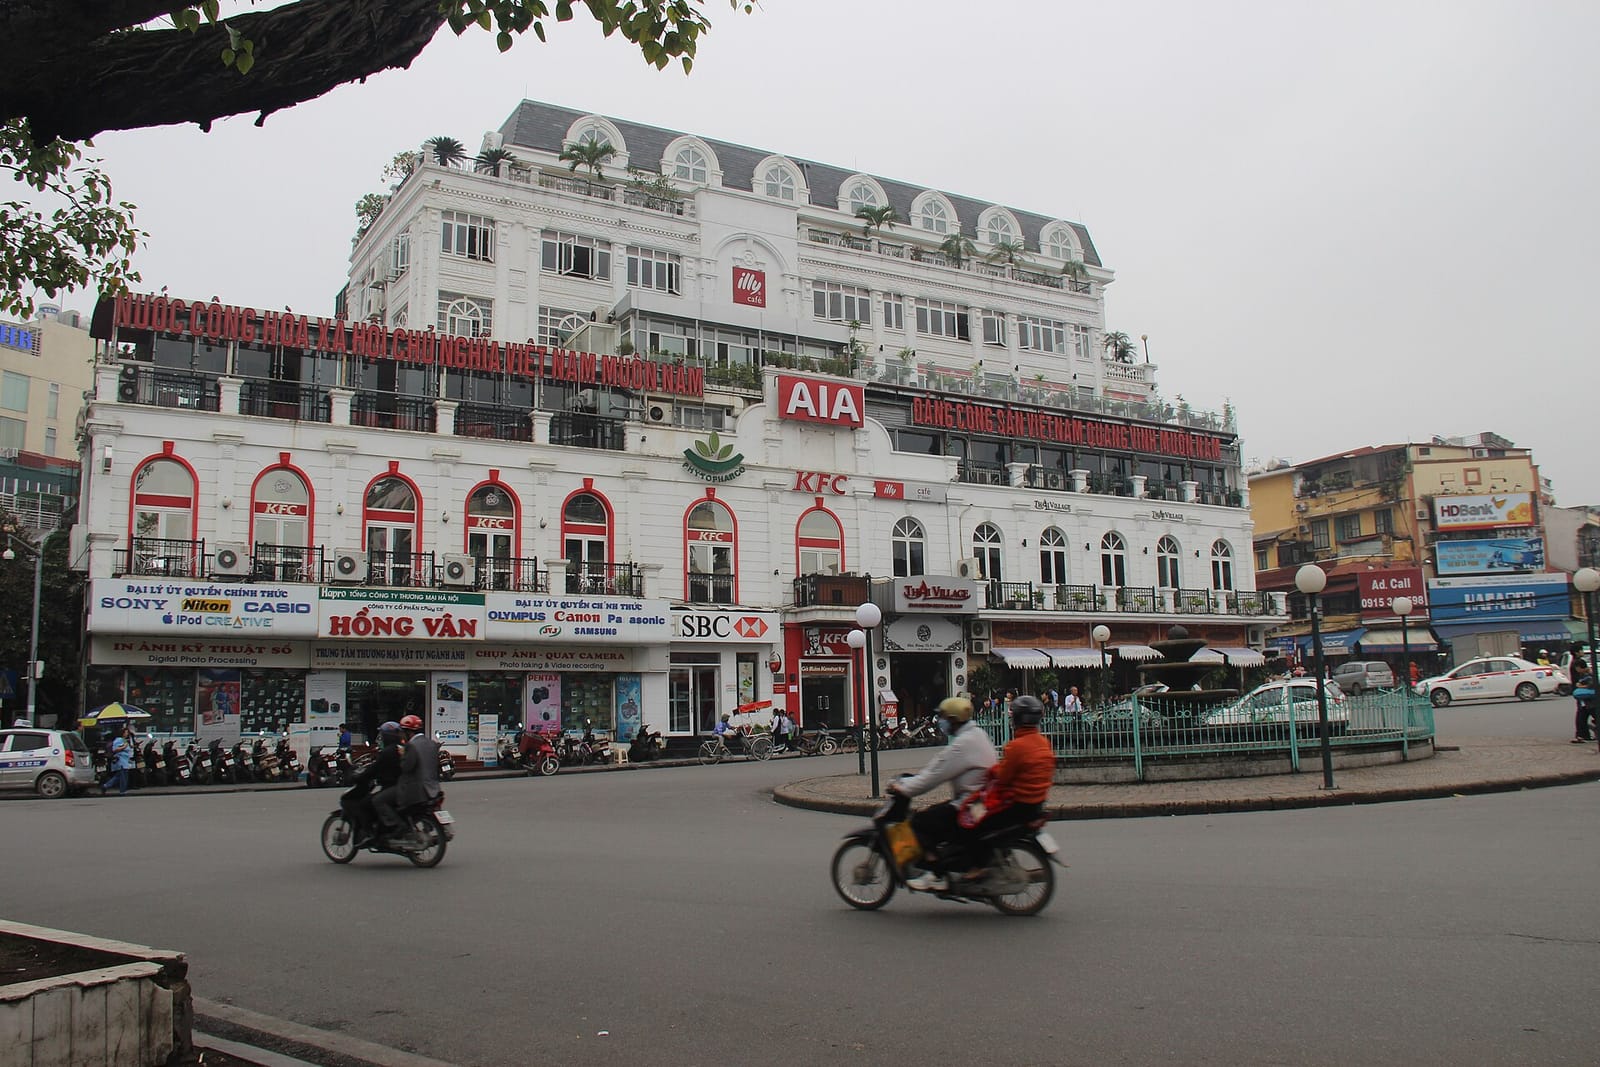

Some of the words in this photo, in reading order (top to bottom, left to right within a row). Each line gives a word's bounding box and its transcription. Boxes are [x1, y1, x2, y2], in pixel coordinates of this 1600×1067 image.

[738, 272, 762, 295] illy
[190, 296, 256, 344] CỘNG
[263, 305, 309, 350] HÒA
[317, 312, 346, 352] XÃ
[352, 317, 388, 361] HỘI
[392, 324, 436, 365] CHỦ
[440, 332, 500, 373] NGHĨA
[506, 338, 547, 380] VIỆT
[552, 347, 596, 384] NAM
[602, 353, 657, 392] MUÔN
[662, 358, 703, 397] NĂM
[786, 381, 860, 422] AIA
[792, 470, 848, 496] KFC
[884, 484, 896, 496] illy
[264, 504, 298, 516] KFC
[1441, 504, 1494, 517] HDBank
[476, 518, 504, 529] KFC
[699, 532, 724, 542] KFC
[904, 580, 931, 598] THAI
[932, 586, 969, 598] VILLAGE
[1372, 580, 1388, 590] Ad.
[1390, 578, 1410, 589] Call
[126, 585, 147, 594] ĐẠI
[224, 587, 257, 597] CHÍNH
[322, 588, 346, 600] Hapro
[101, 598, 168, 610] SONY
[184, 600, 229, 612] Nikon
[244, 601, 310, 614] CASIO
[1362, 598, 1384, 608] 0915
[488, 610, 546, 621] OLYMPUS
[554, 611, 600, 623] Canon
[204, 616, 274, 628] CREATIVE
[330, 606, 414, 636] HỒNG
[422, 613, 478, 638] VÂN
[574, 627, 617, 636] SAMSUNG
[822, 634, 848, 644] KFC
[113, 643, 134, 651] IN
[148, 655, 178, 664] Digital
[180, 656, 206, 664] Photo
[208, 656, 257, 666] Processing
[476, 650, 507, 660] CHỤP
[546, 652, 576, 660] QUAY
[579, 652, 624, 660] CAMERA
[521, 662, 542, 670] taking
[551, 662, 571, 670] Video
[572, 662, 604, 671] recording
[528, 674, 560, 682] PENTAX
